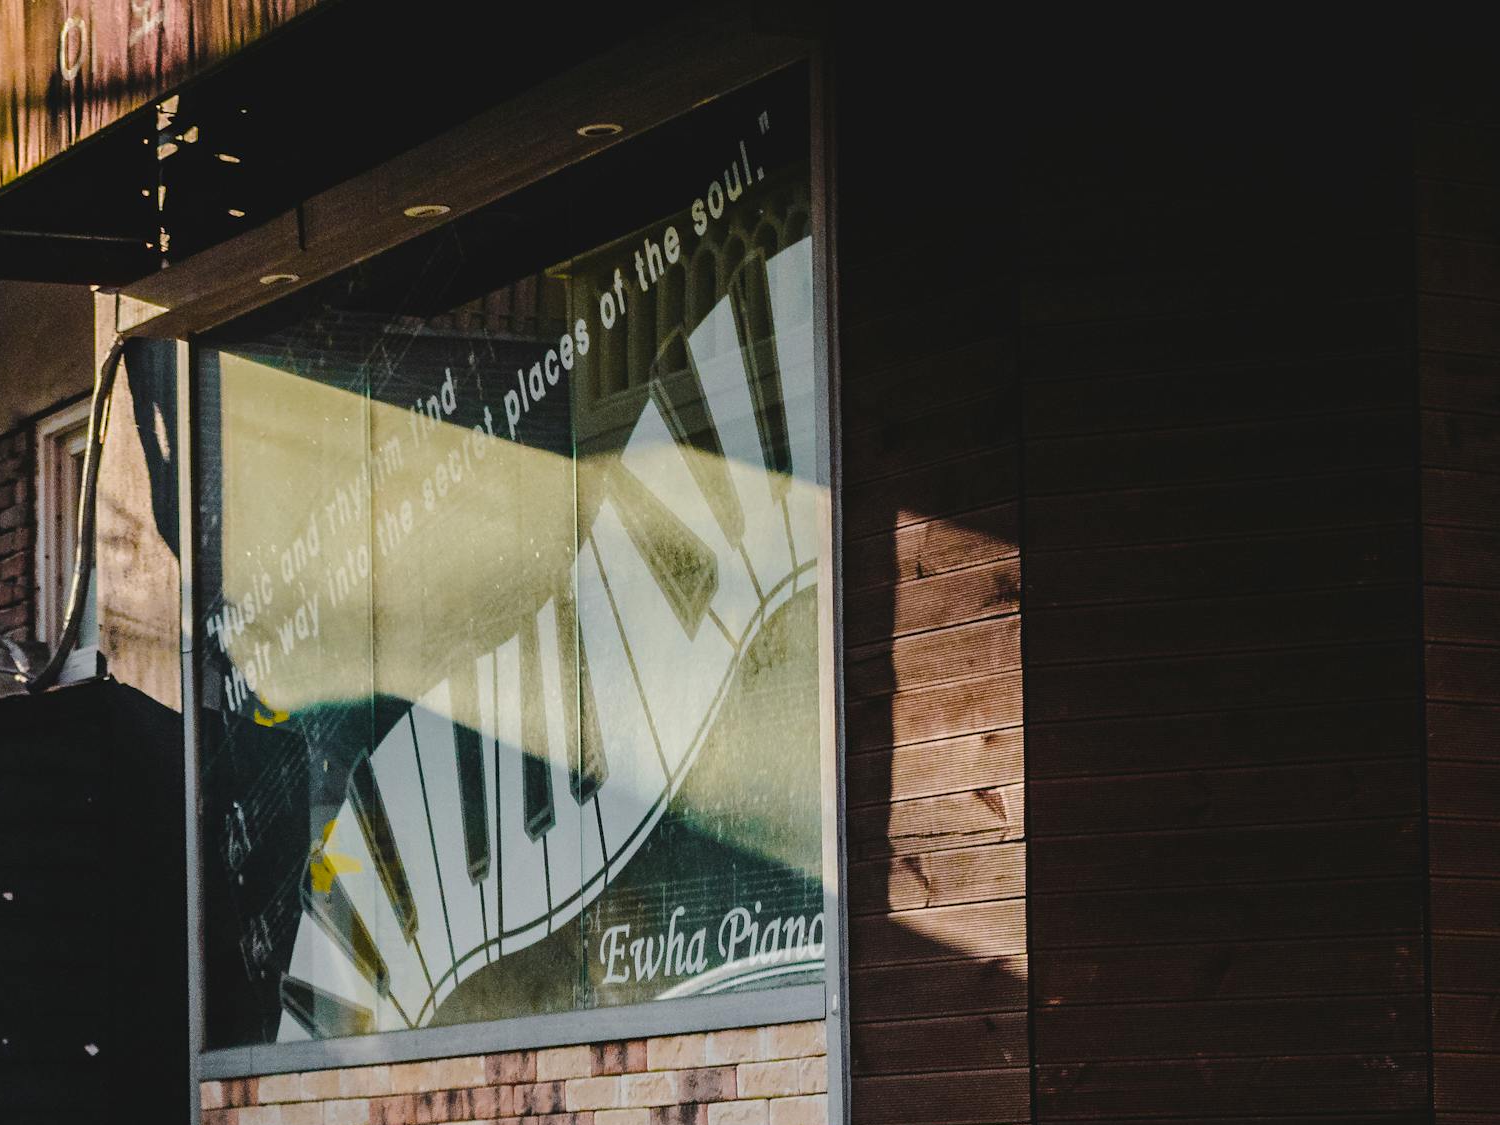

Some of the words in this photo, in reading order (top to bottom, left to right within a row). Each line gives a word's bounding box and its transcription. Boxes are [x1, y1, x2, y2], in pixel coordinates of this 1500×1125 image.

[224, 641, 271, 713] their
[277, 593, 320, 656] way
[326, 544, 369, 608] into
[376, 500, 413, 557] the
[423, 405, 495, 512] secret
[504, 318, 590, 441] places
[600, 267, 626, 330] of
[634, 226, 681, 293] the
[281, 513, 320, 584] and
[407, 367, 457, 449] find
[600, 905, 708, 985] Ewha
[717, 900, 825, 965] Piano
